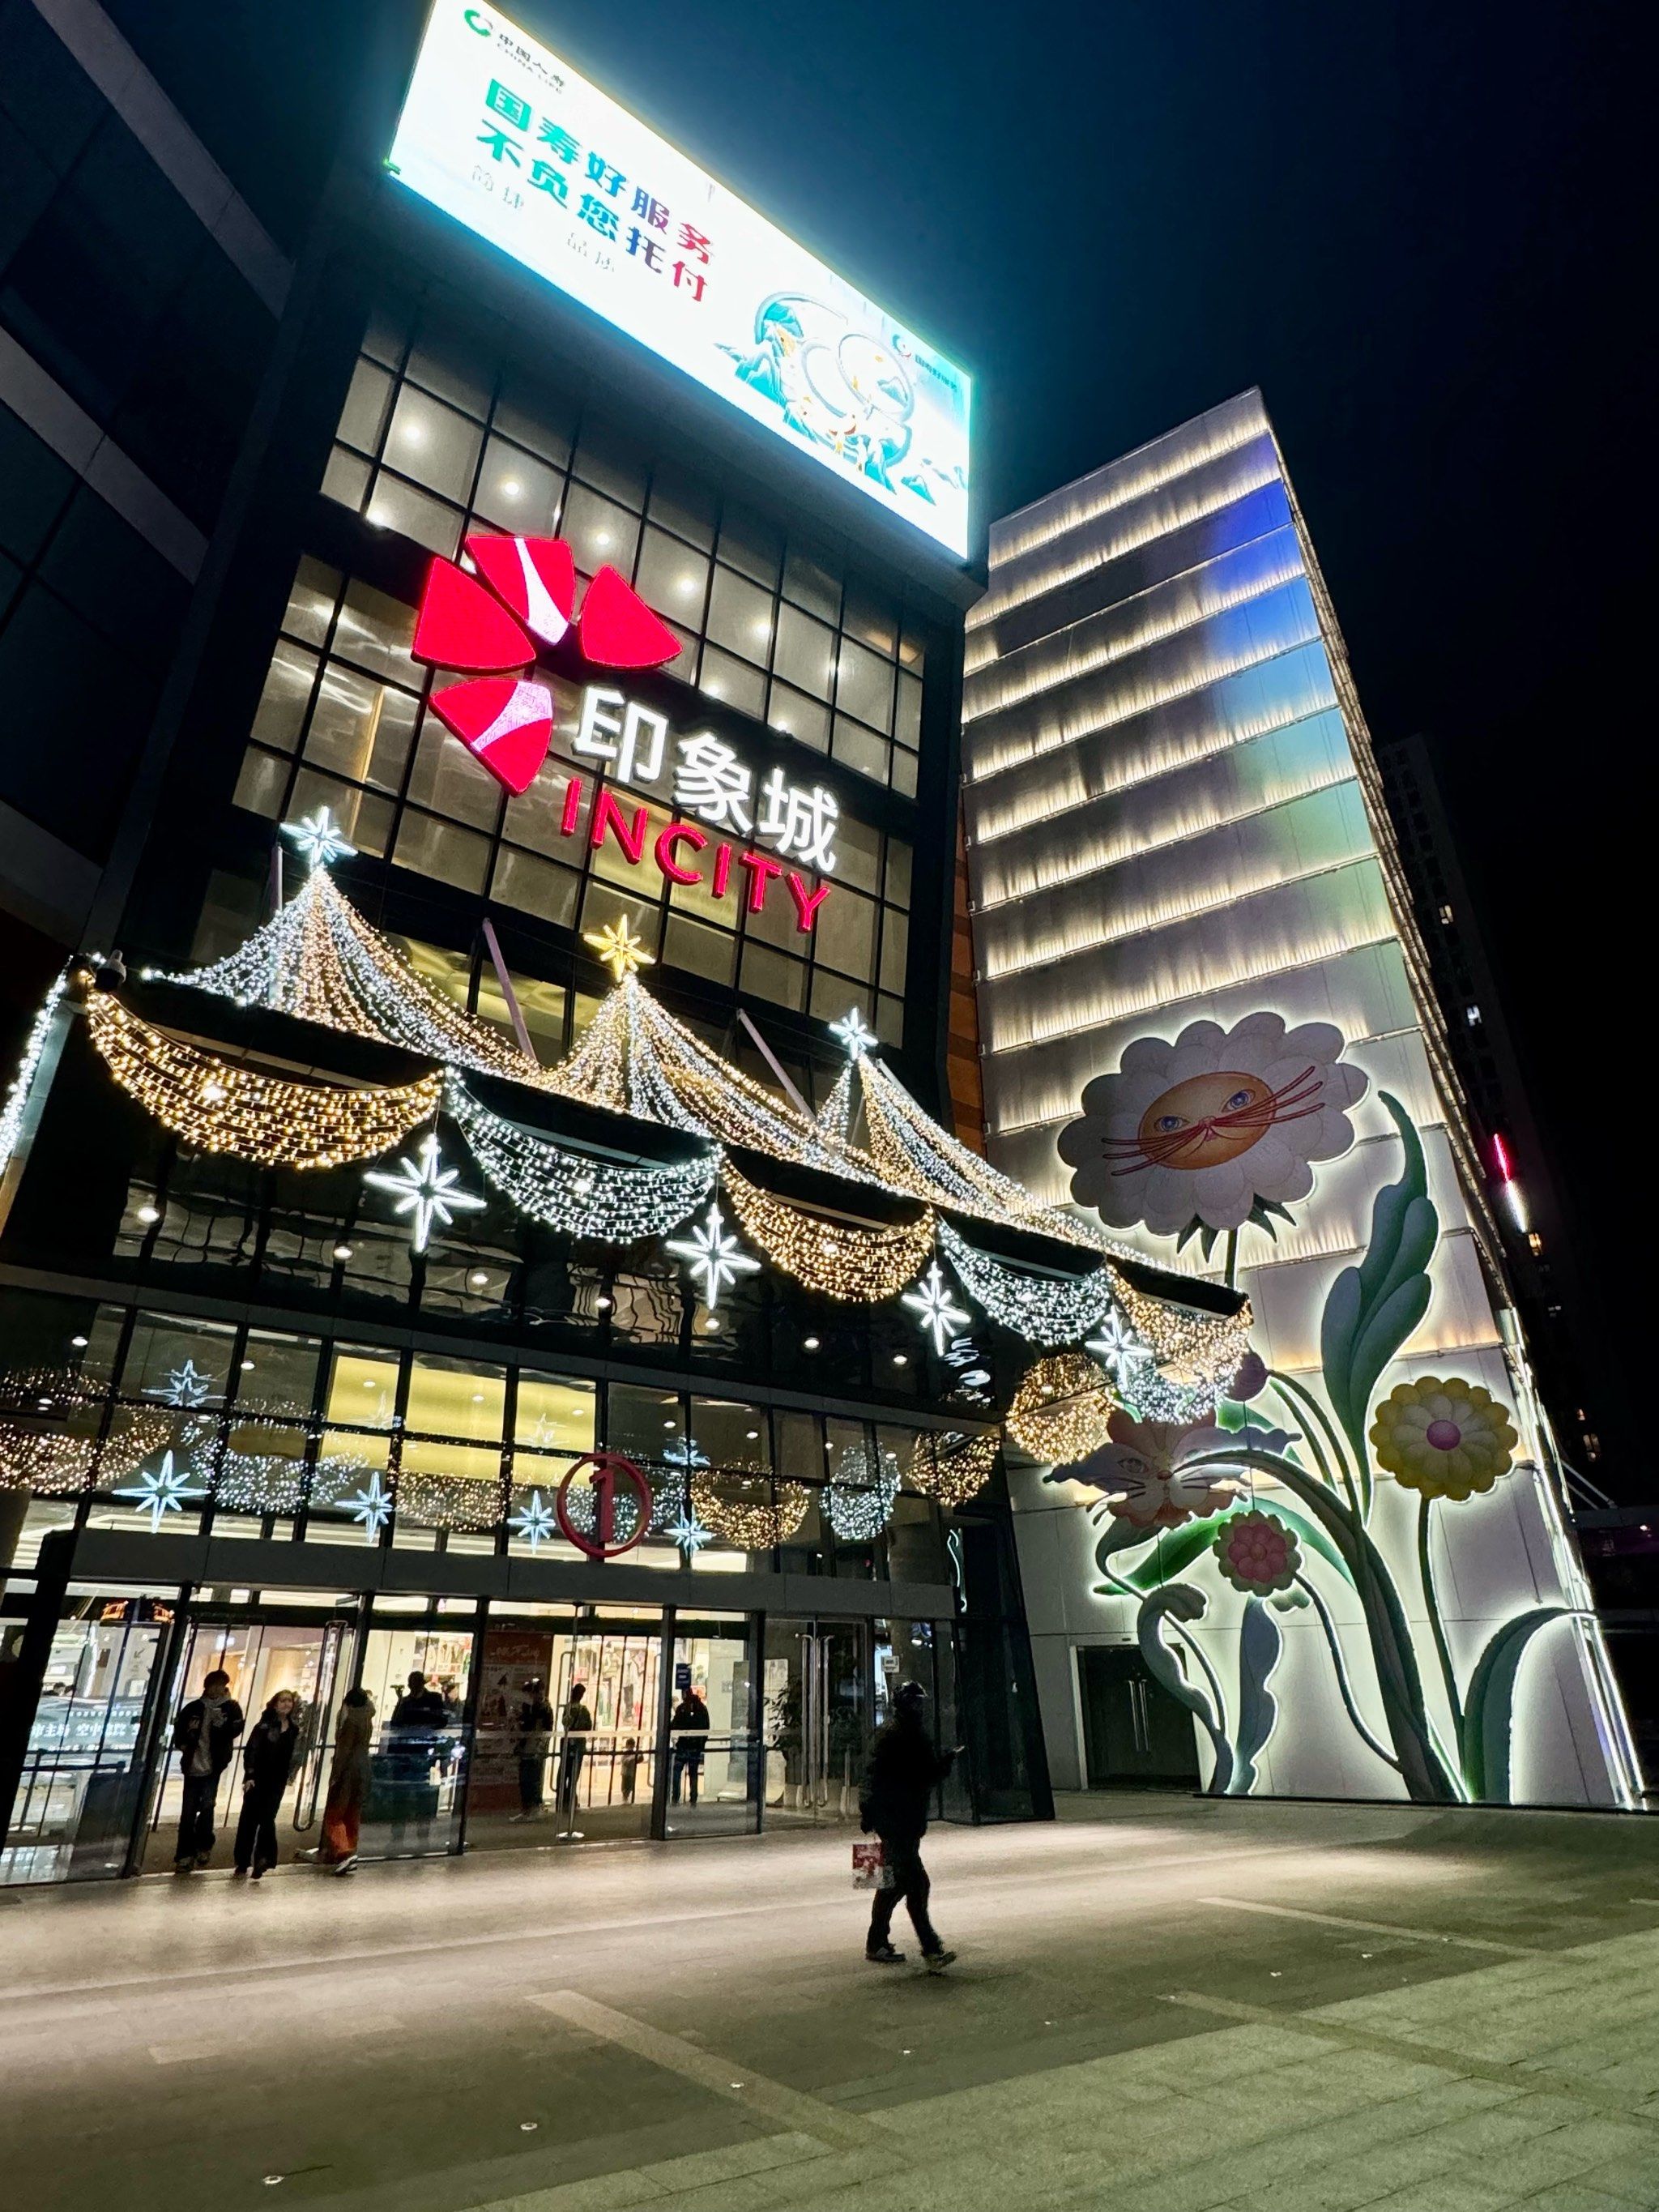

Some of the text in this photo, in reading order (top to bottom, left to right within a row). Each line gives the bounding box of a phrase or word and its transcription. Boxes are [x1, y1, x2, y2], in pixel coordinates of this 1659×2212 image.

[476, 119, 707, 302] 不负您托付
[485, 79, 714, 265] 国寿好服务
[561, 777, 831, 933] INCITY
[572, 685, 839, 873] 印象城
[589, 1467, 615, 1542] 1
